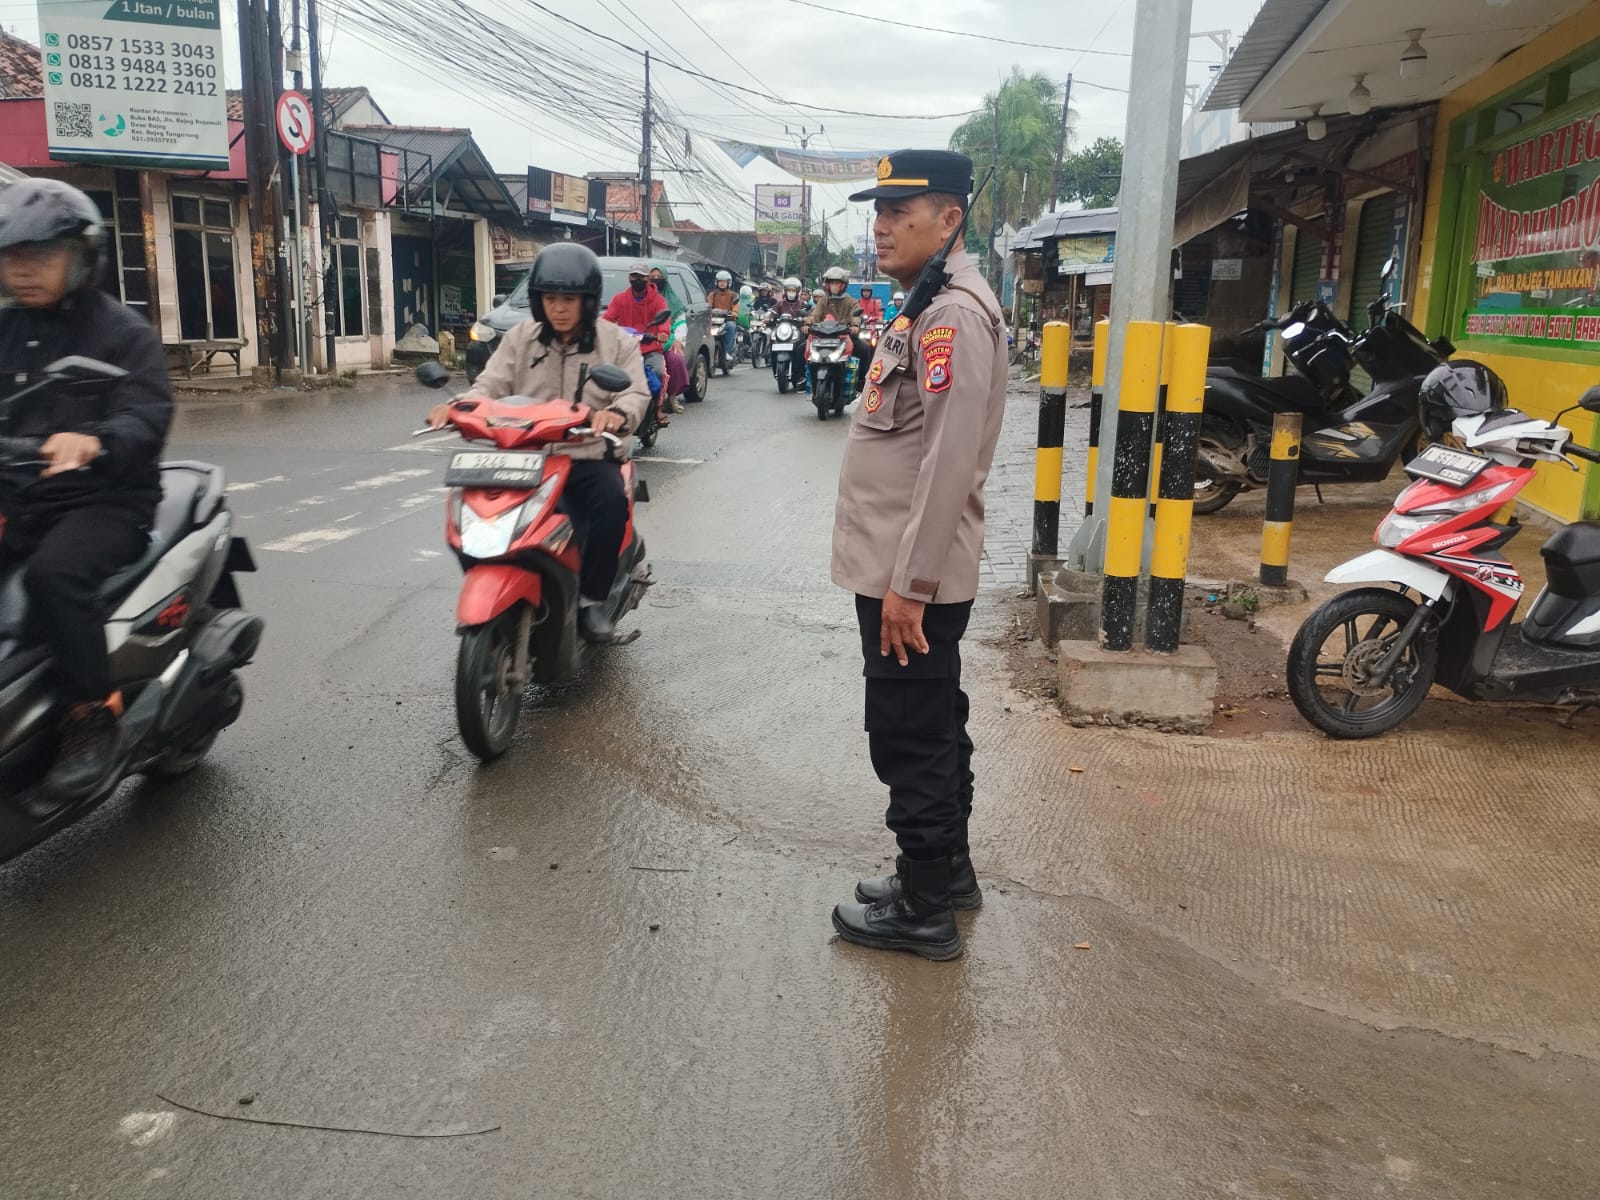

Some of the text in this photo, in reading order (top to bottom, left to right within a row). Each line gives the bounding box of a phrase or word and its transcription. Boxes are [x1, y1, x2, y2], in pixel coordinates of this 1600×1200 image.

[122, 1, 215, 20] 1 Jtan / bulan
[67, 33, 215, 60] 0857 1533 3043
[69, 53, 216, 79] 0813 9484 3360
[70, 72, 218, 97] 0812 1222 2412
[1506, 111, 1600, 188] WARTEG
[1471, 175, 1600, 264] JAYABAHARIO
[1517, 271, 1542, 291] RAJEG
[1545, 268, 1593, 289] TANJAKAN
[1505, 314, 1529, 337] AYAM
[1528, 314, 1548, 338] DAN
[1547, 315, 1574, 340] SOTO
[1432, 534, 1468, 549] HONDA
